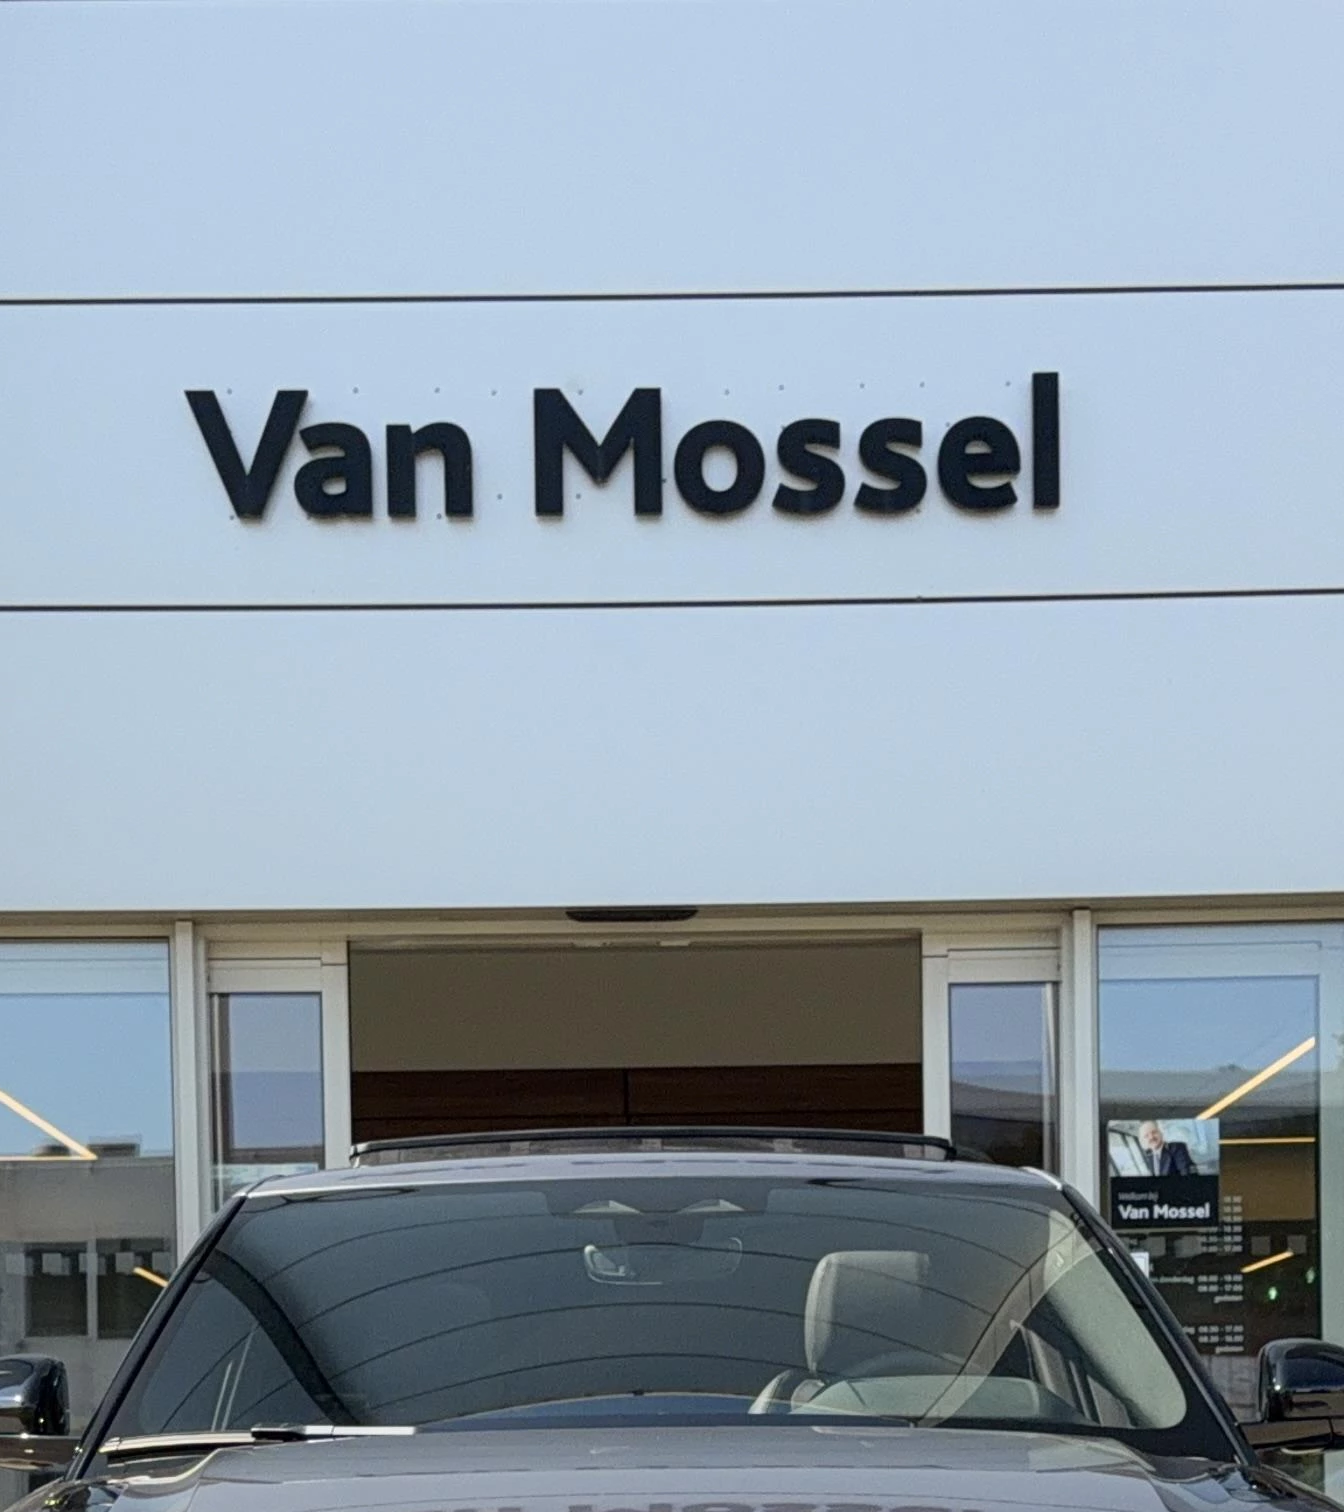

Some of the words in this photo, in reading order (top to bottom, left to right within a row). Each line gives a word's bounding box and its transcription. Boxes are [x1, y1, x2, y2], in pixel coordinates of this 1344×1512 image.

[184, 389, 474, 520] Van
[533, 372, 1060, 518] Mossel
[1118, 1204, 1149, 1219] Van
[1153, 1202, 1210, 1219] Mossel
